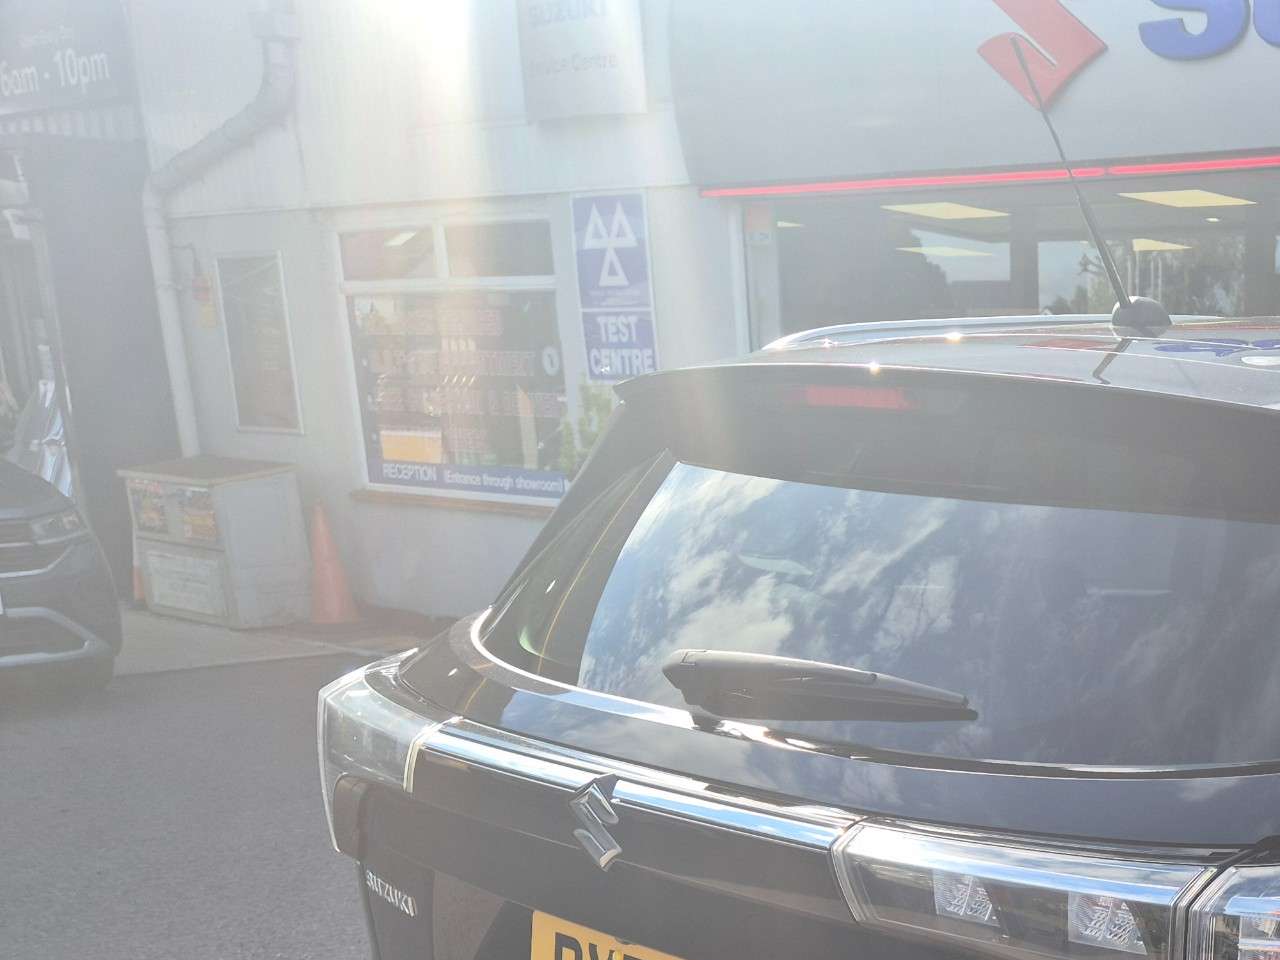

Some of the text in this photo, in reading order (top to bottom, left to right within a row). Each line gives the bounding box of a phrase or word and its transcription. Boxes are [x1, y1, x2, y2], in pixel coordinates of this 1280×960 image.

[53, 48, 111, 96] 10pm
[596, 315, 639, 342] TEST
[589, 347, 654, 375] CENTRE
[382, 463, 437, 481] RECEPTION
[483, 472, 514, 490] through
